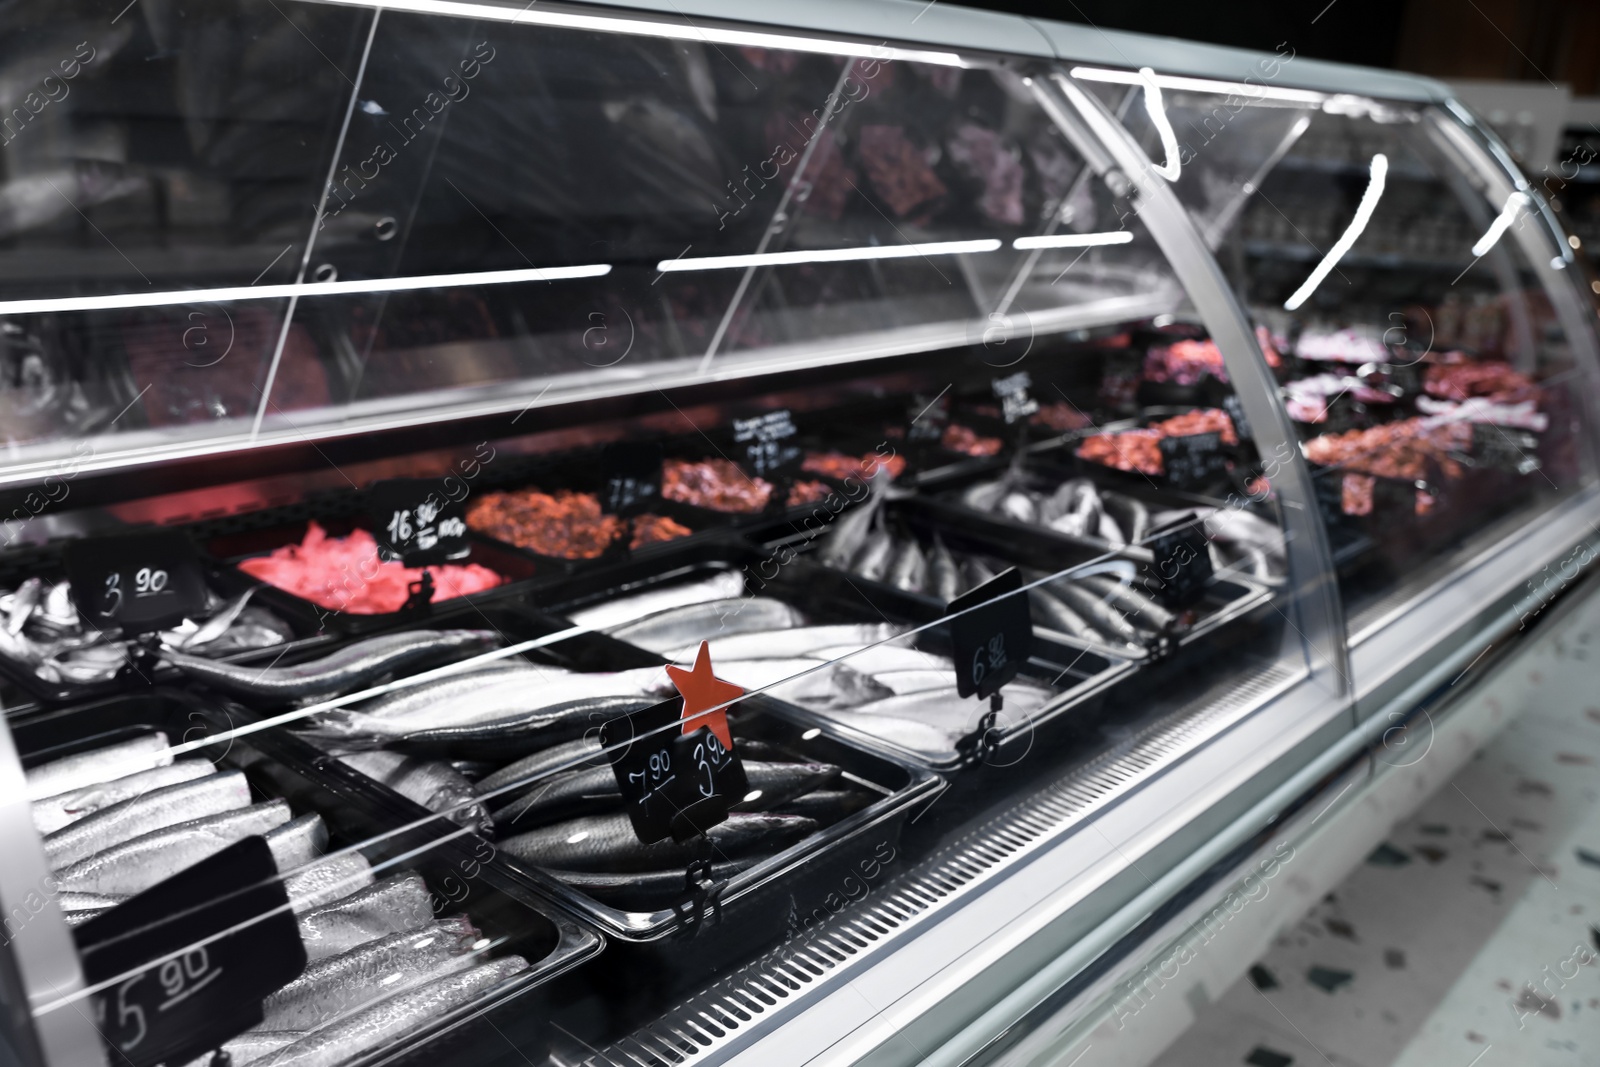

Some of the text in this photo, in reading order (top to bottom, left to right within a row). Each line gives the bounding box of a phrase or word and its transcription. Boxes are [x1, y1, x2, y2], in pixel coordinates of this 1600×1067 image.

[100, 567, 168, 616] 3 90
[973, 646, 985, 685] 6
[650, 749, 670, 780] 90
[693, 743, 713, 797] 3
[160, 946, 209, 995] 90
